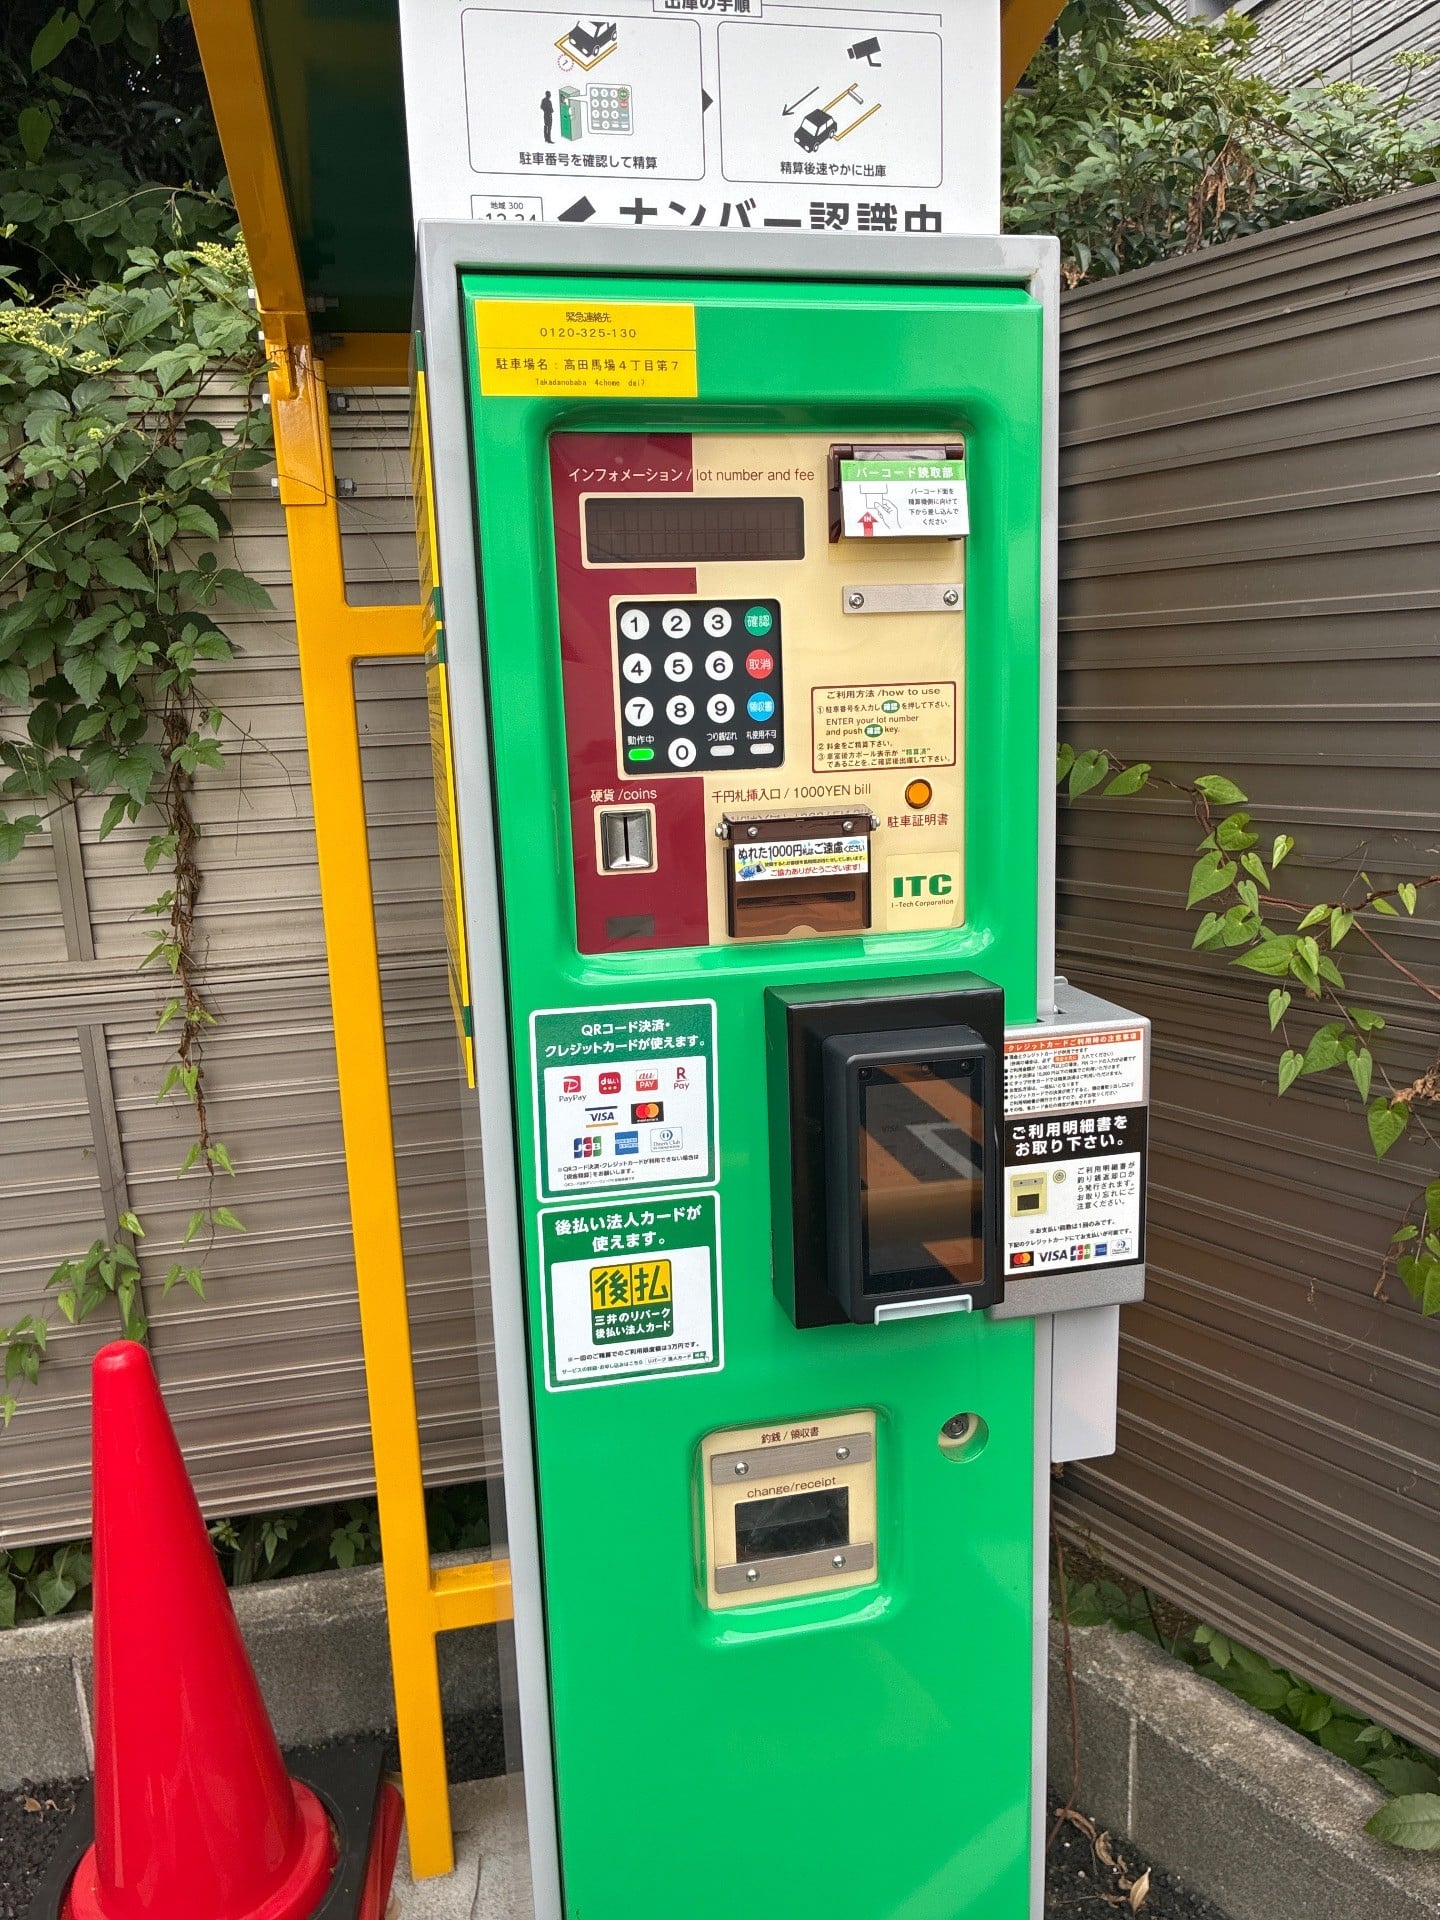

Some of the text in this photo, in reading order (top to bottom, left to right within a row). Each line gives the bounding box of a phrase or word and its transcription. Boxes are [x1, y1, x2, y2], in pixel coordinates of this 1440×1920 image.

[519, 152, 658, 169] 駐車番号を確認して精算
[780, 161, 886, 177] 精算後速やかに出庫
[509, 202, 524, 210] 300
[566, 312, 612, 323] 緊急連絡先
[540, 327, 637, 338] 0120-325-130
[535, 379, 587, 387] Takadanobaba
[568, 467, 683, 482] インフォメーション
[696, 469, 712, 481] lot
[716, 469, 763, 481] number
[767, 469, 790, 481] and
[795, 469, 815, 481] fee
[856, 467, 953, 478] バーコード読取部
[909, 508, 959, 516] 下から差し込んで
[630, 617, 638, 632] 1
[671, 616, 683, 631] 2
[711, 615, 724, 630] 3
[747, 615, 770, 628] 確認
[631, 661, 644, 676] 4
[672, 659, 685, 675] 5
[713, 658, 726, 673] 6
[749, 658, 771, 670] 取消
[827, 689, 875, 700] ご利用方法
[908, 688, 918, 696] to
[633, 704, 645, 719] 7
[674, 703, 687, 718] 8
[714, 701, 727, 716] 9
[826, 718, 854, 726] ENTER
[856, 717, 874, 726] your
[889, 715, 919, 723] number
[706, 731, 737, 742] つり銭切れ
[746, 729, 777, 739] 札使用不可
[843, 728, 863, 737] push
[885, 726, 900, 734] key.
[627, 735, 655, 746] 動作中
[676, 745, 689, 760] 0
[590, 789, 615, 803] 硬貨
[712, 789, 781, 804] 千円札挿入口
[794, 785, 850, 798] 1000YEN
[854, 783, 871, 795] bill
[887, 813, 949, 828] 駐車証明書
[893, 873, 952, 898] ITC
[915, 898, 954, 908] Corporation
[545, 1035, 705, 1058] クレジットカードが使えます。
[639, 1081, 655, 1089] PAY
[673, 1082, 690, 1090] Pay
[559, 1095, 587, 1103] PayPay
[590, 1111, 615, 1122] VISA
[1012, 1116, 1128, 1140] ご利用明細書を
[1016, 1134, 1124, 1157] お取り下さい。
[1077, 1161, 1135, 1174] ご利用明細書が
[1077, 1188, 1135, 1201] お取り忘れにご
[1077, 1199, 1125, 1210] 注意ください。
[555, 1205, 702, 1236] 後払い法人カードが
[592, 1231, 666, 1253] 使えます。
[1039, 1250, 1068, 1263] VISA
[594, 1265, 669, 1307] 後払
[594, 1307, 671, 1326] 三井のリパーク
[595, 1321, 671, 1339] 後払い法人カード
[761, 1432, 781, 1444] 釣銭
[790, 1426, 819, 1440] 領収書
[747, 1476, 837, 1499] change/receipt
